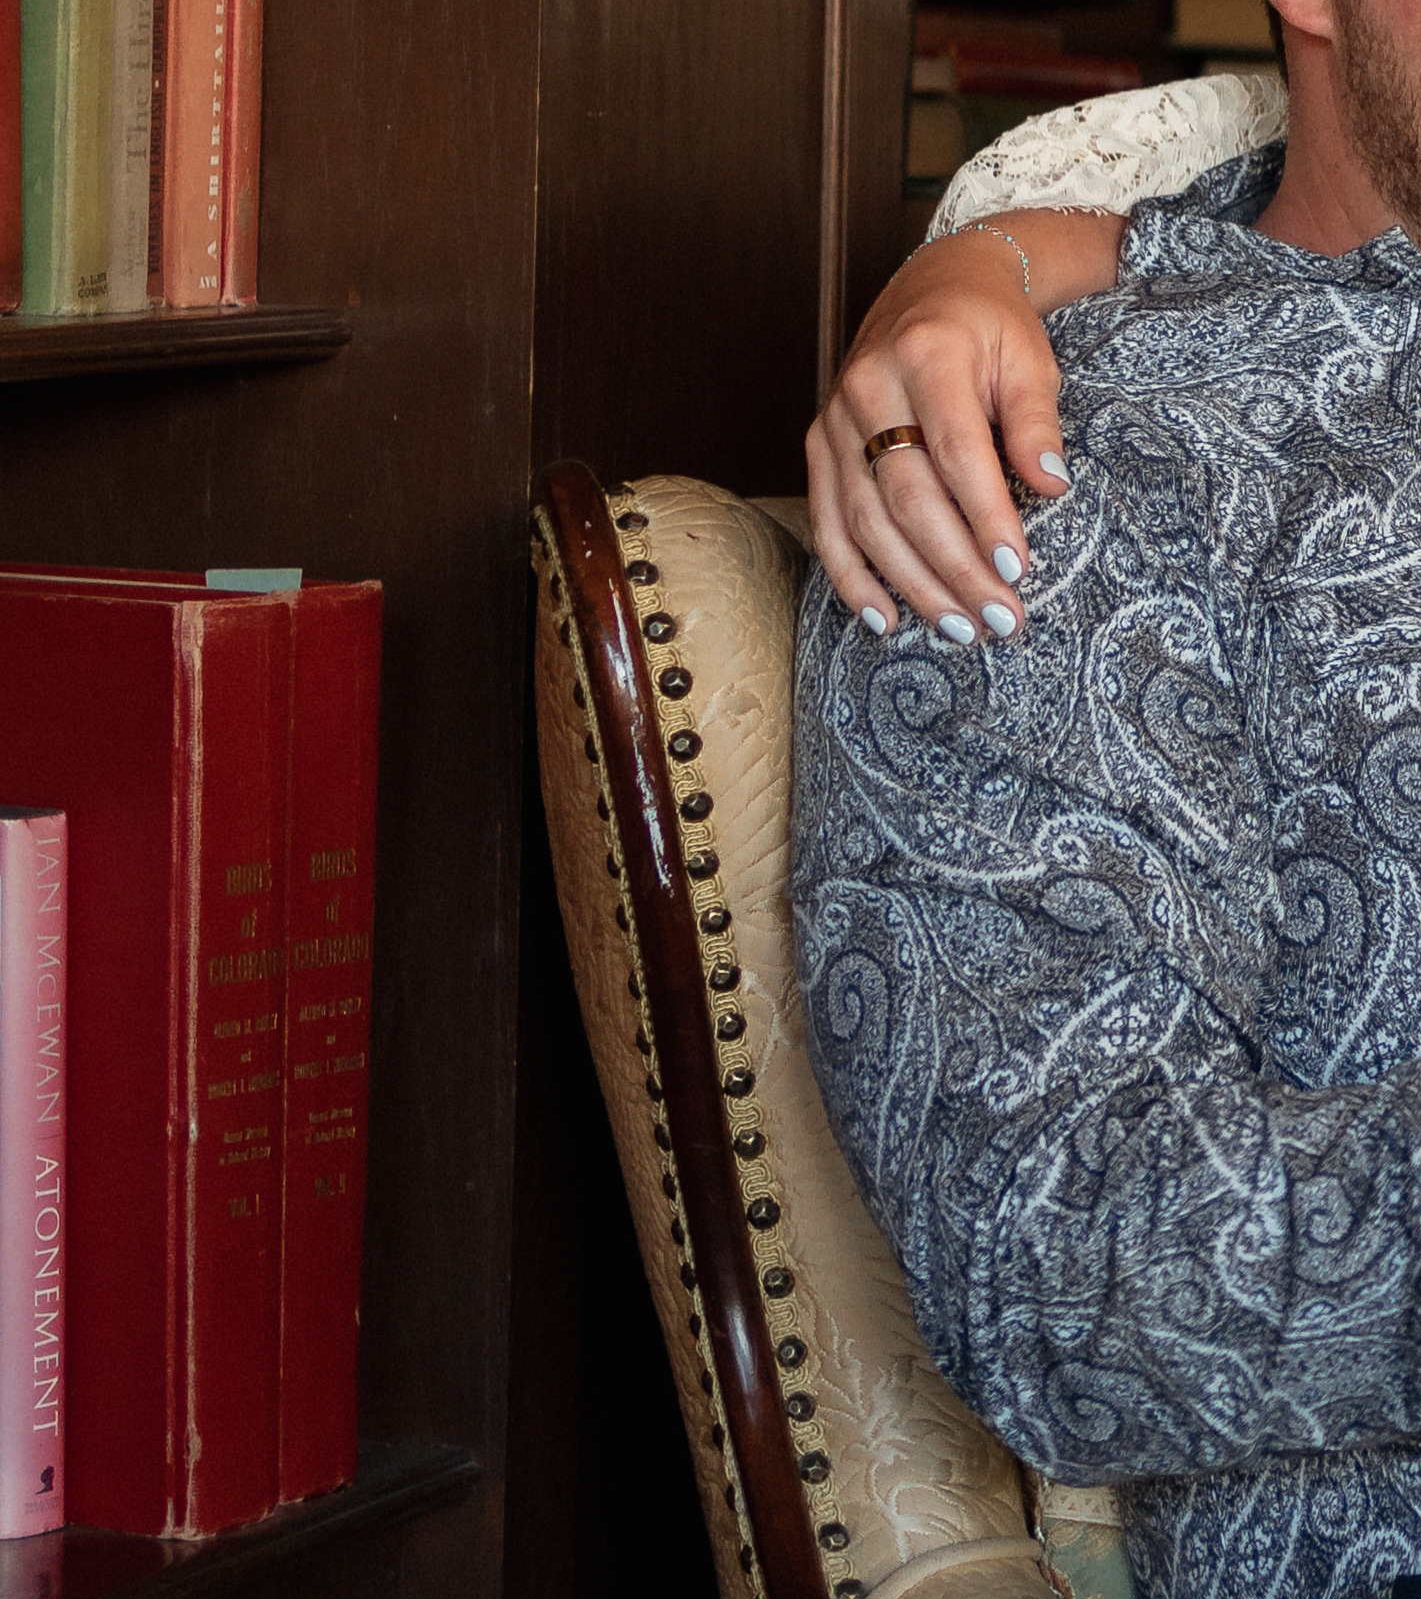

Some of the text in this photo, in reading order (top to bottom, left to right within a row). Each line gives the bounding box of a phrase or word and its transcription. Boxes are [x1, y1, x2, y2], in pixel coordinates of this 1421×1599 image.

[126, 86, 148, 174] The
[150, 91, 162, 166] ENGLISH
[150, 174, 161, 194] IN
[206, 240, 217, 262] A
[37, 836, 61, 915] IAN
[225, 861, 273, 897] BIRDS
[310, 846, 357, 882] BIRDS
[240, 907, 258, 939] of
[325, 892, 340, 923] of
[294, 931, 369, 971] COLORADO
[33, 1153, 61, 1436] ATONEMENT
